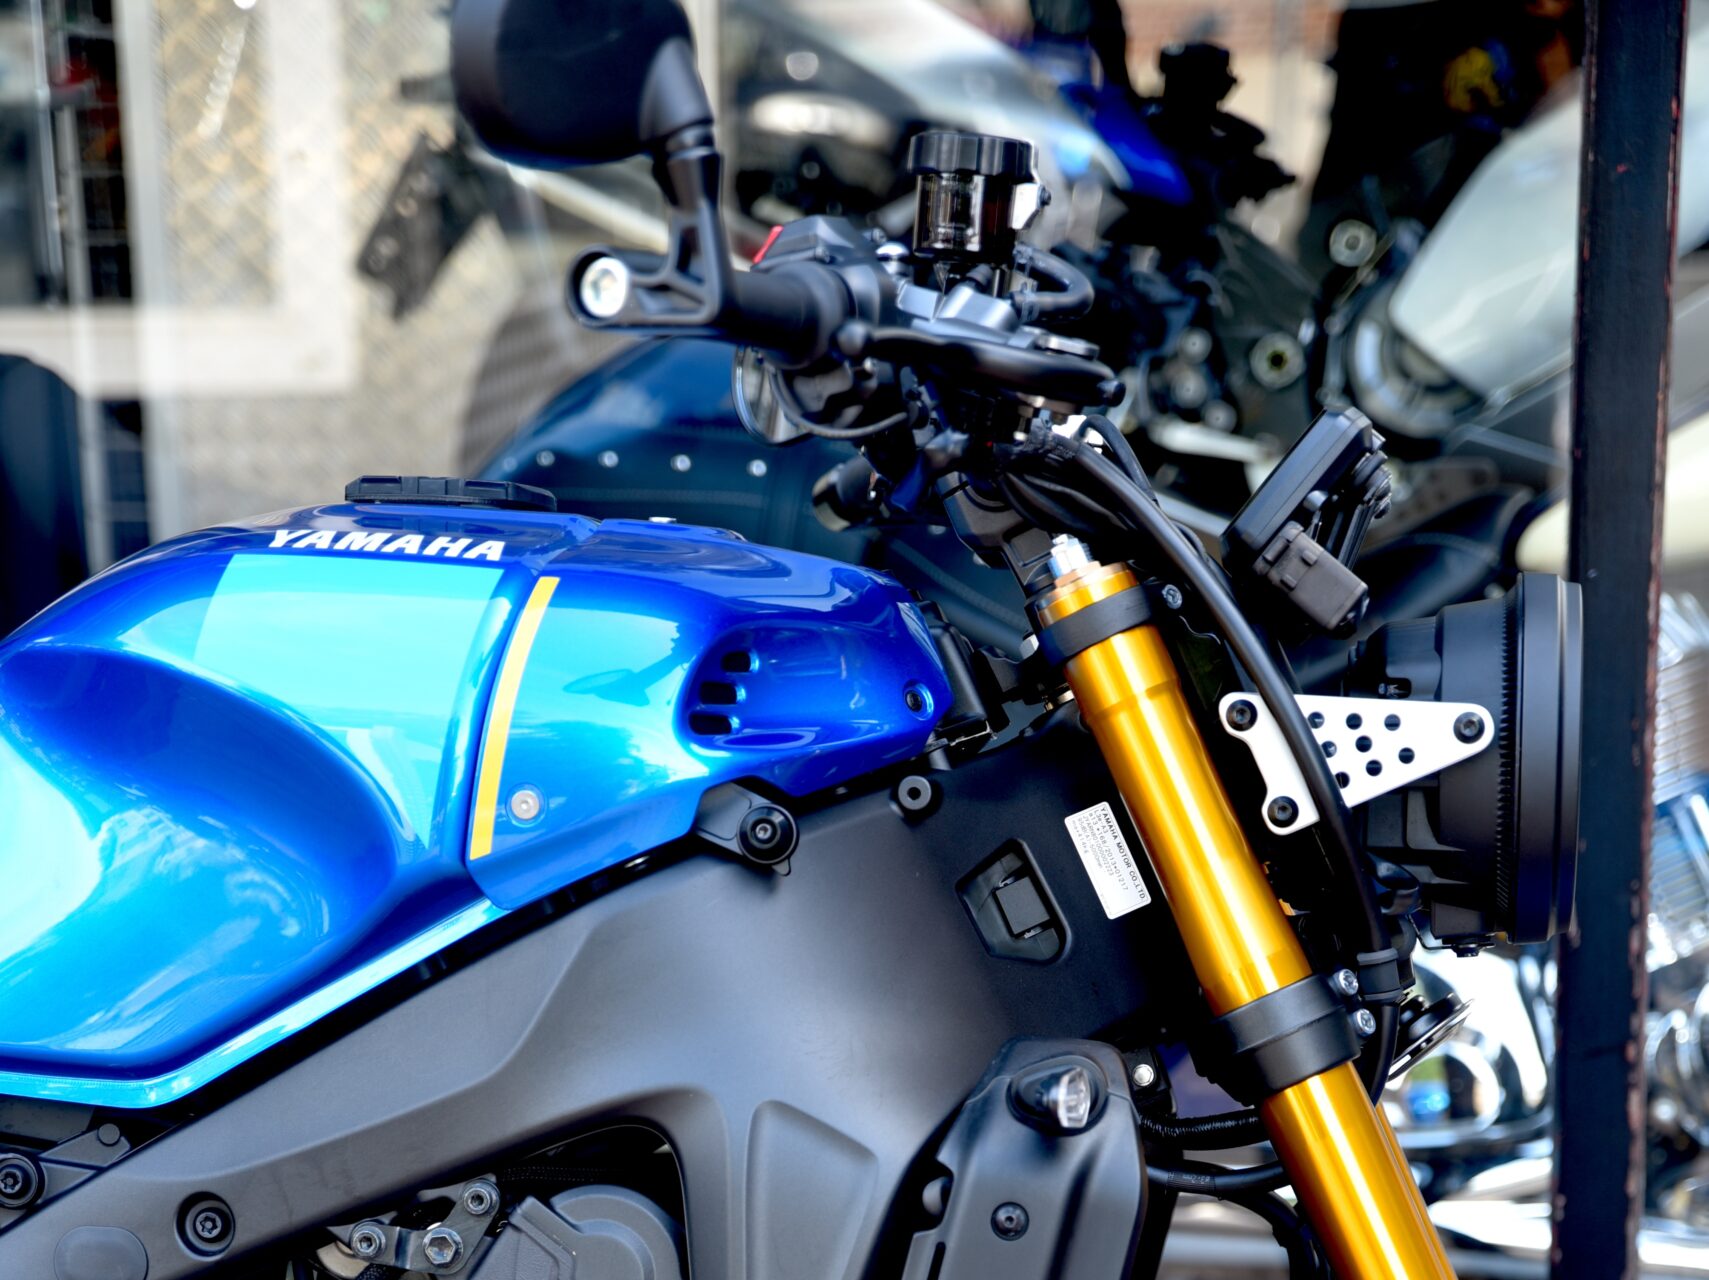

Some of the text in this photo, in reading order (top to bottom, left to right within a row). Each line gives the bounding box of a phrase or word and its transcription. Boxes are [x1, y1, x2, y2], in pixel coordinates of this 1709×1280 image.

[268, 529, 505, 561] YAMAHA
[1100, 806, 1119, 840] YAMAHA
[1115, 841, 1131, 868] MOTOR
